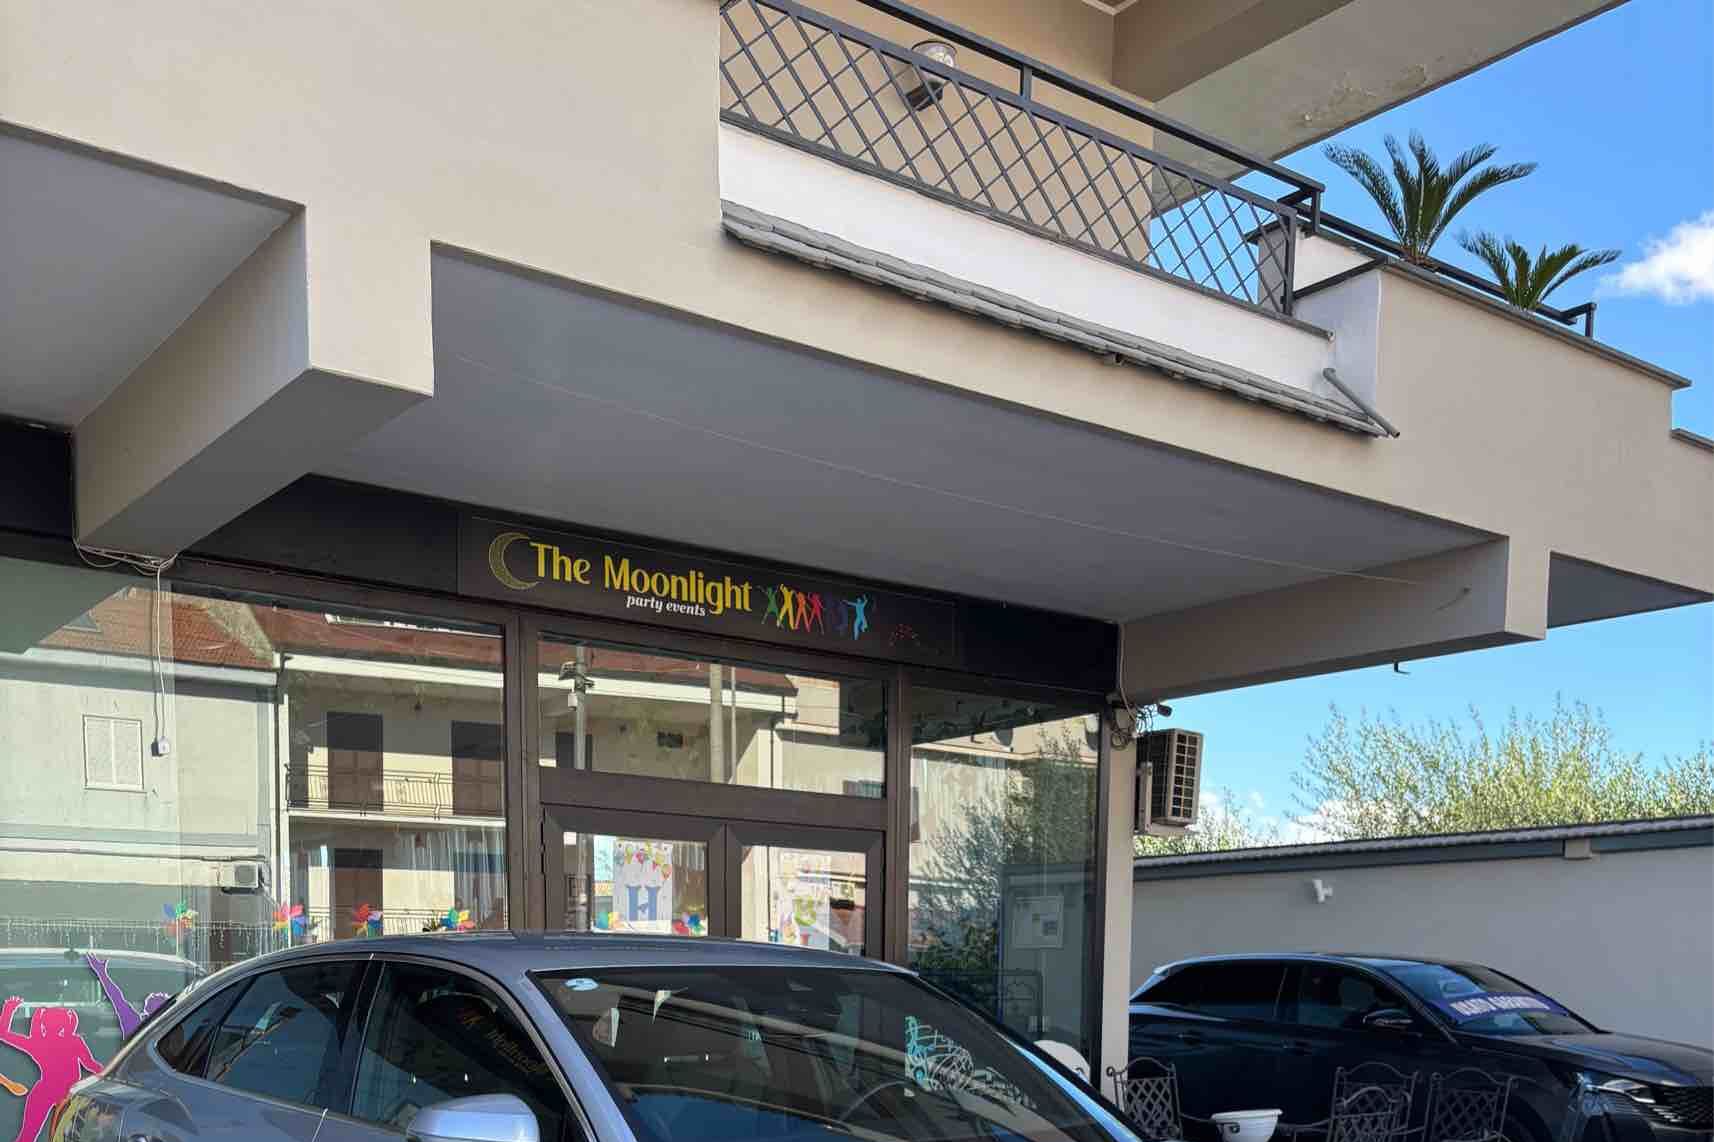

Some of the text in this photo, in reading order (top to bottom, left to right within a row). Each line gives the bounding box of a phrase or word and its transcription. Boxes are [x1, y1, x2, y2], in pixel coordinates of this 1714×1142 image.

[530, 542, 752, 615] The Moonlight
[626, 595, 706, 617] party events
